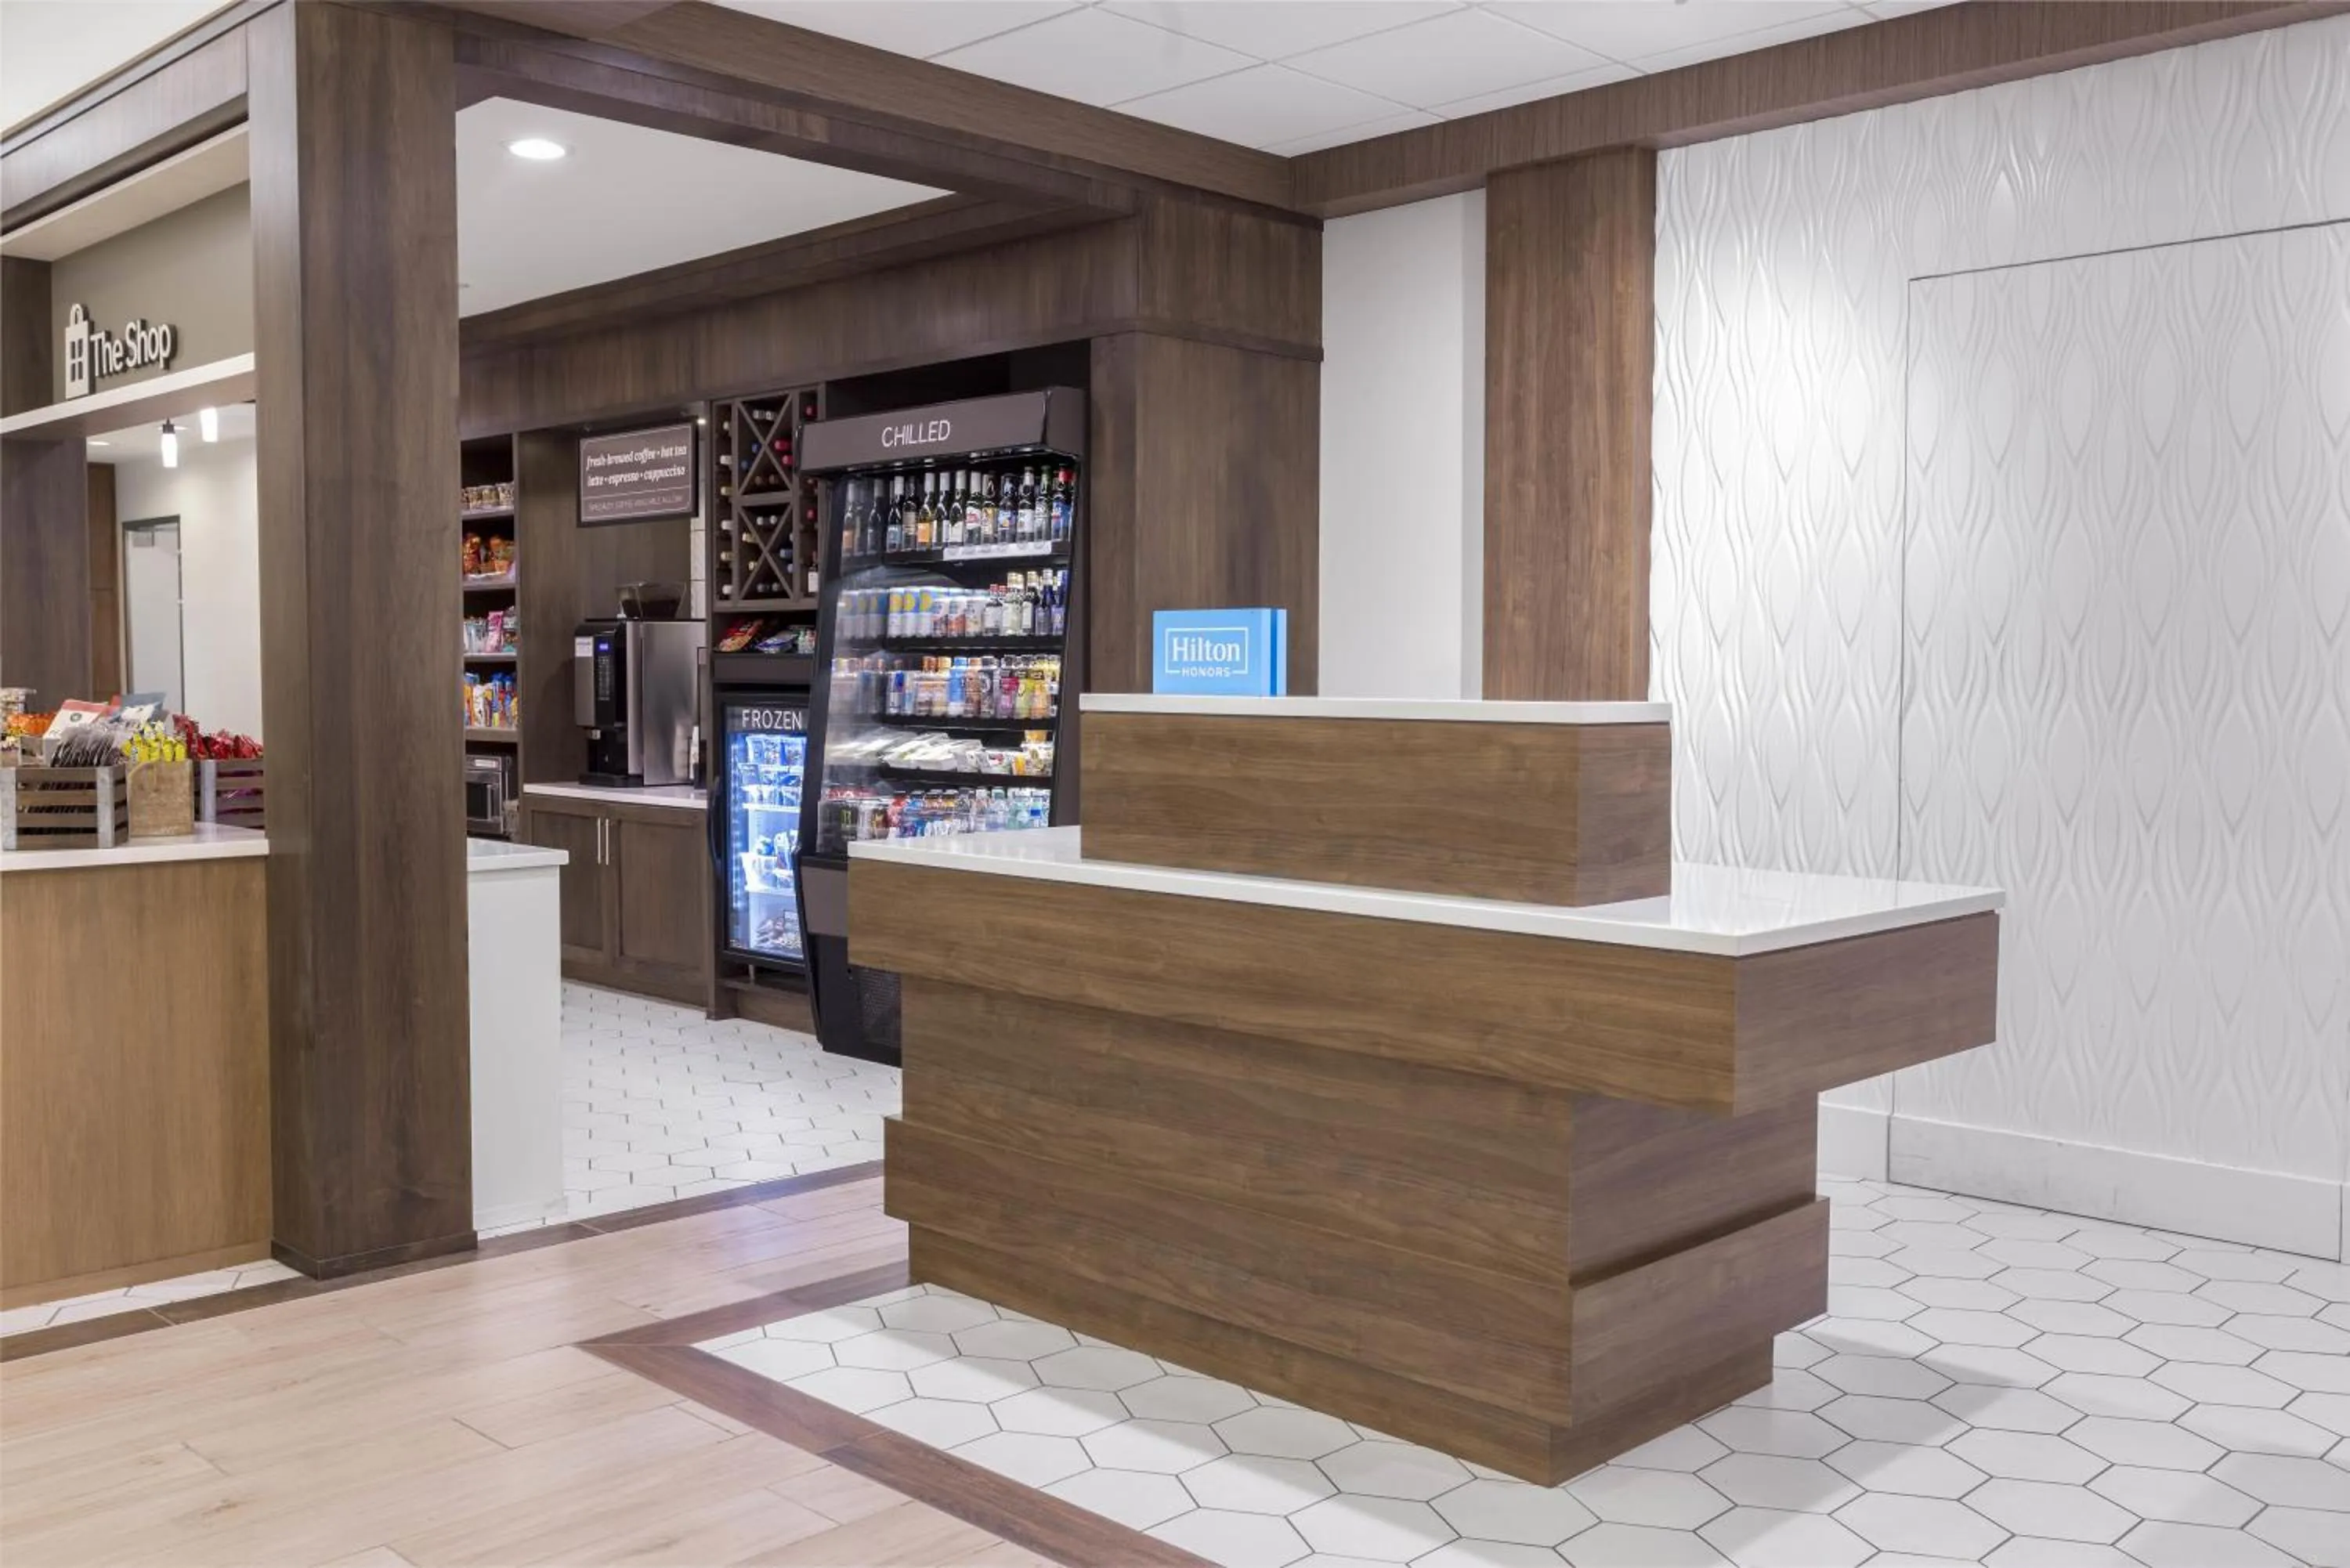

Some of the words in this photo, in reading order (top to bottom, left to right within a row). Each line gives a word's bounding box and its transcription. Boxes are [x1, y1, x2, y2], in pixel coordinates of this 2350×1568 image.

[90, 330, 124, 378] The
[125, 318, 172, 370] Shop
[881, 420, 951, 448] CHILLED
[1172, 637, 1240, 662] Hilton
[1181, 667, 1231, 677] HONORS
[742, 709, 802, 730] FROZEN
